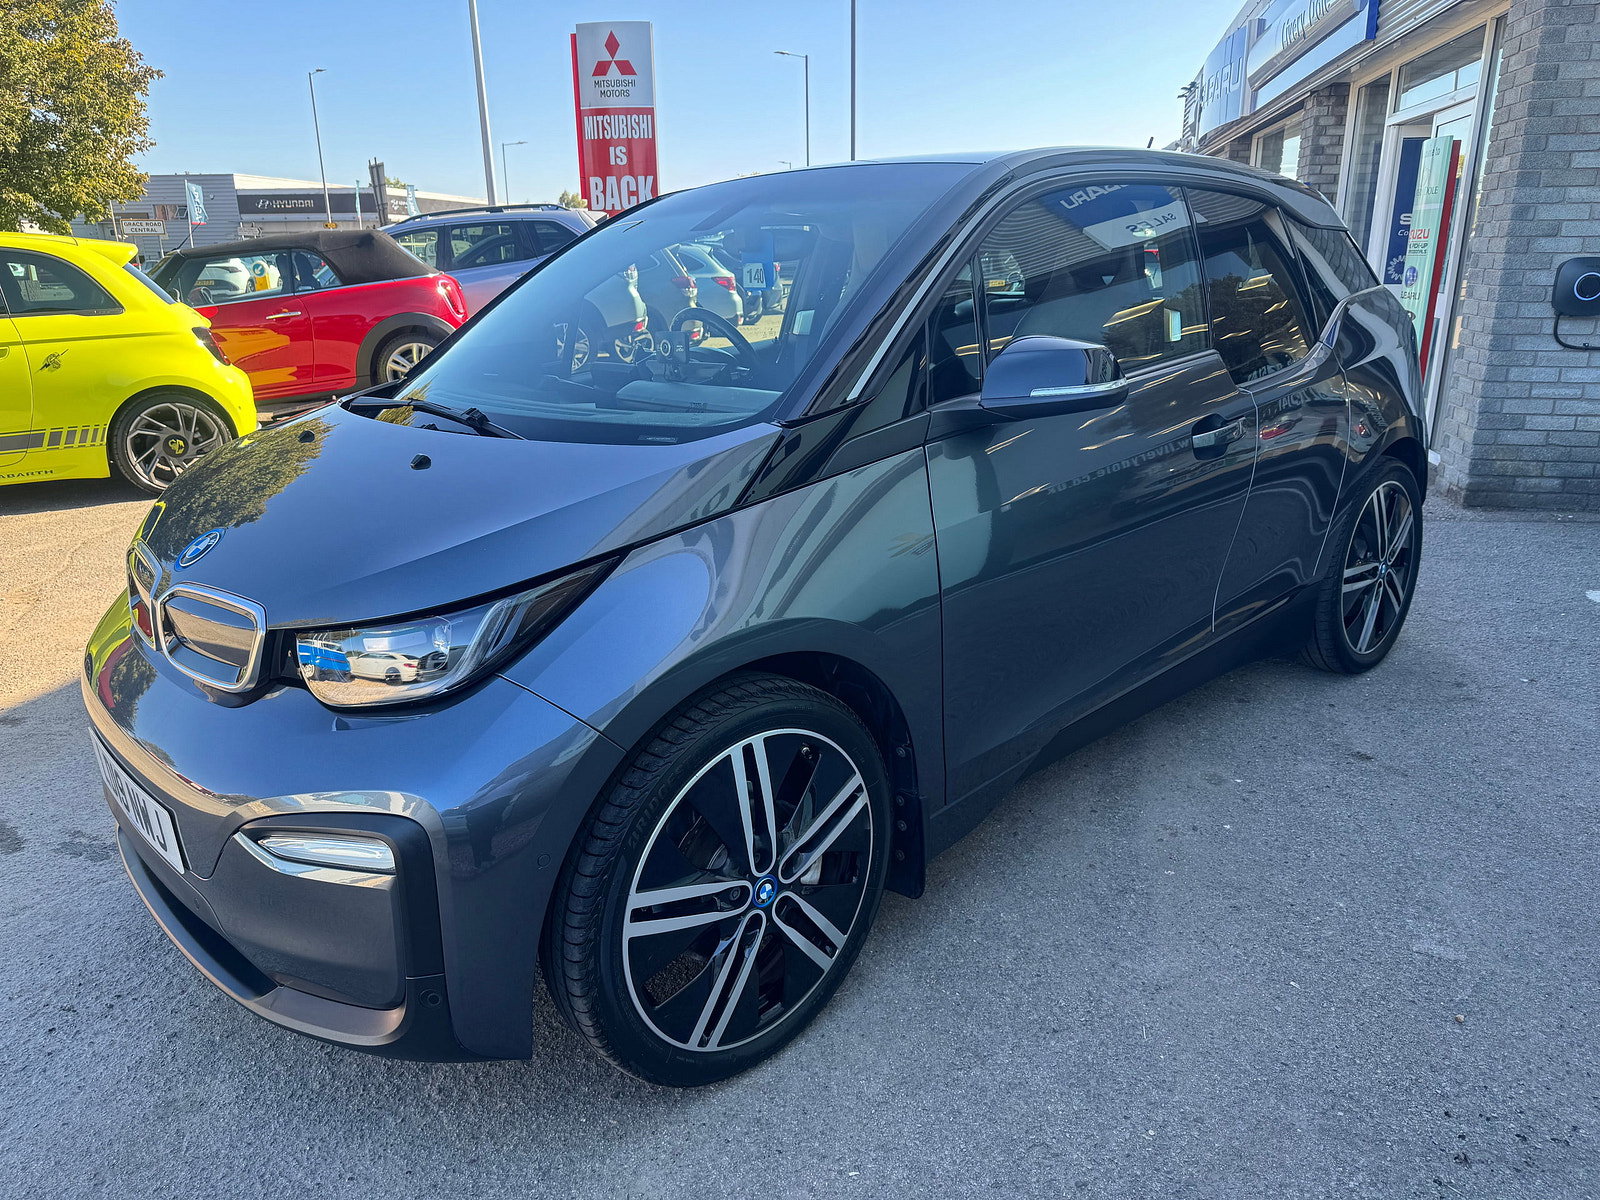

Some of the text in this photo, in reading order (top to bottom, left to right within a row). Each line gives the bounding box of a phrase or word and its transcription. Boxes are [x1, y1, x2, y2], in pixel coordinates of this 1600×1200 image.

[593, 79, 636, 88] MITSUBISHI
[600, 89, 630, 98] MOTORS
[584, 114, 653, 140] MITSUBISHI
[609, 146, 628, 165] IS
[589, 175, 654, 211] BACK
[273, 199, 314, 208] HYUNDAI
